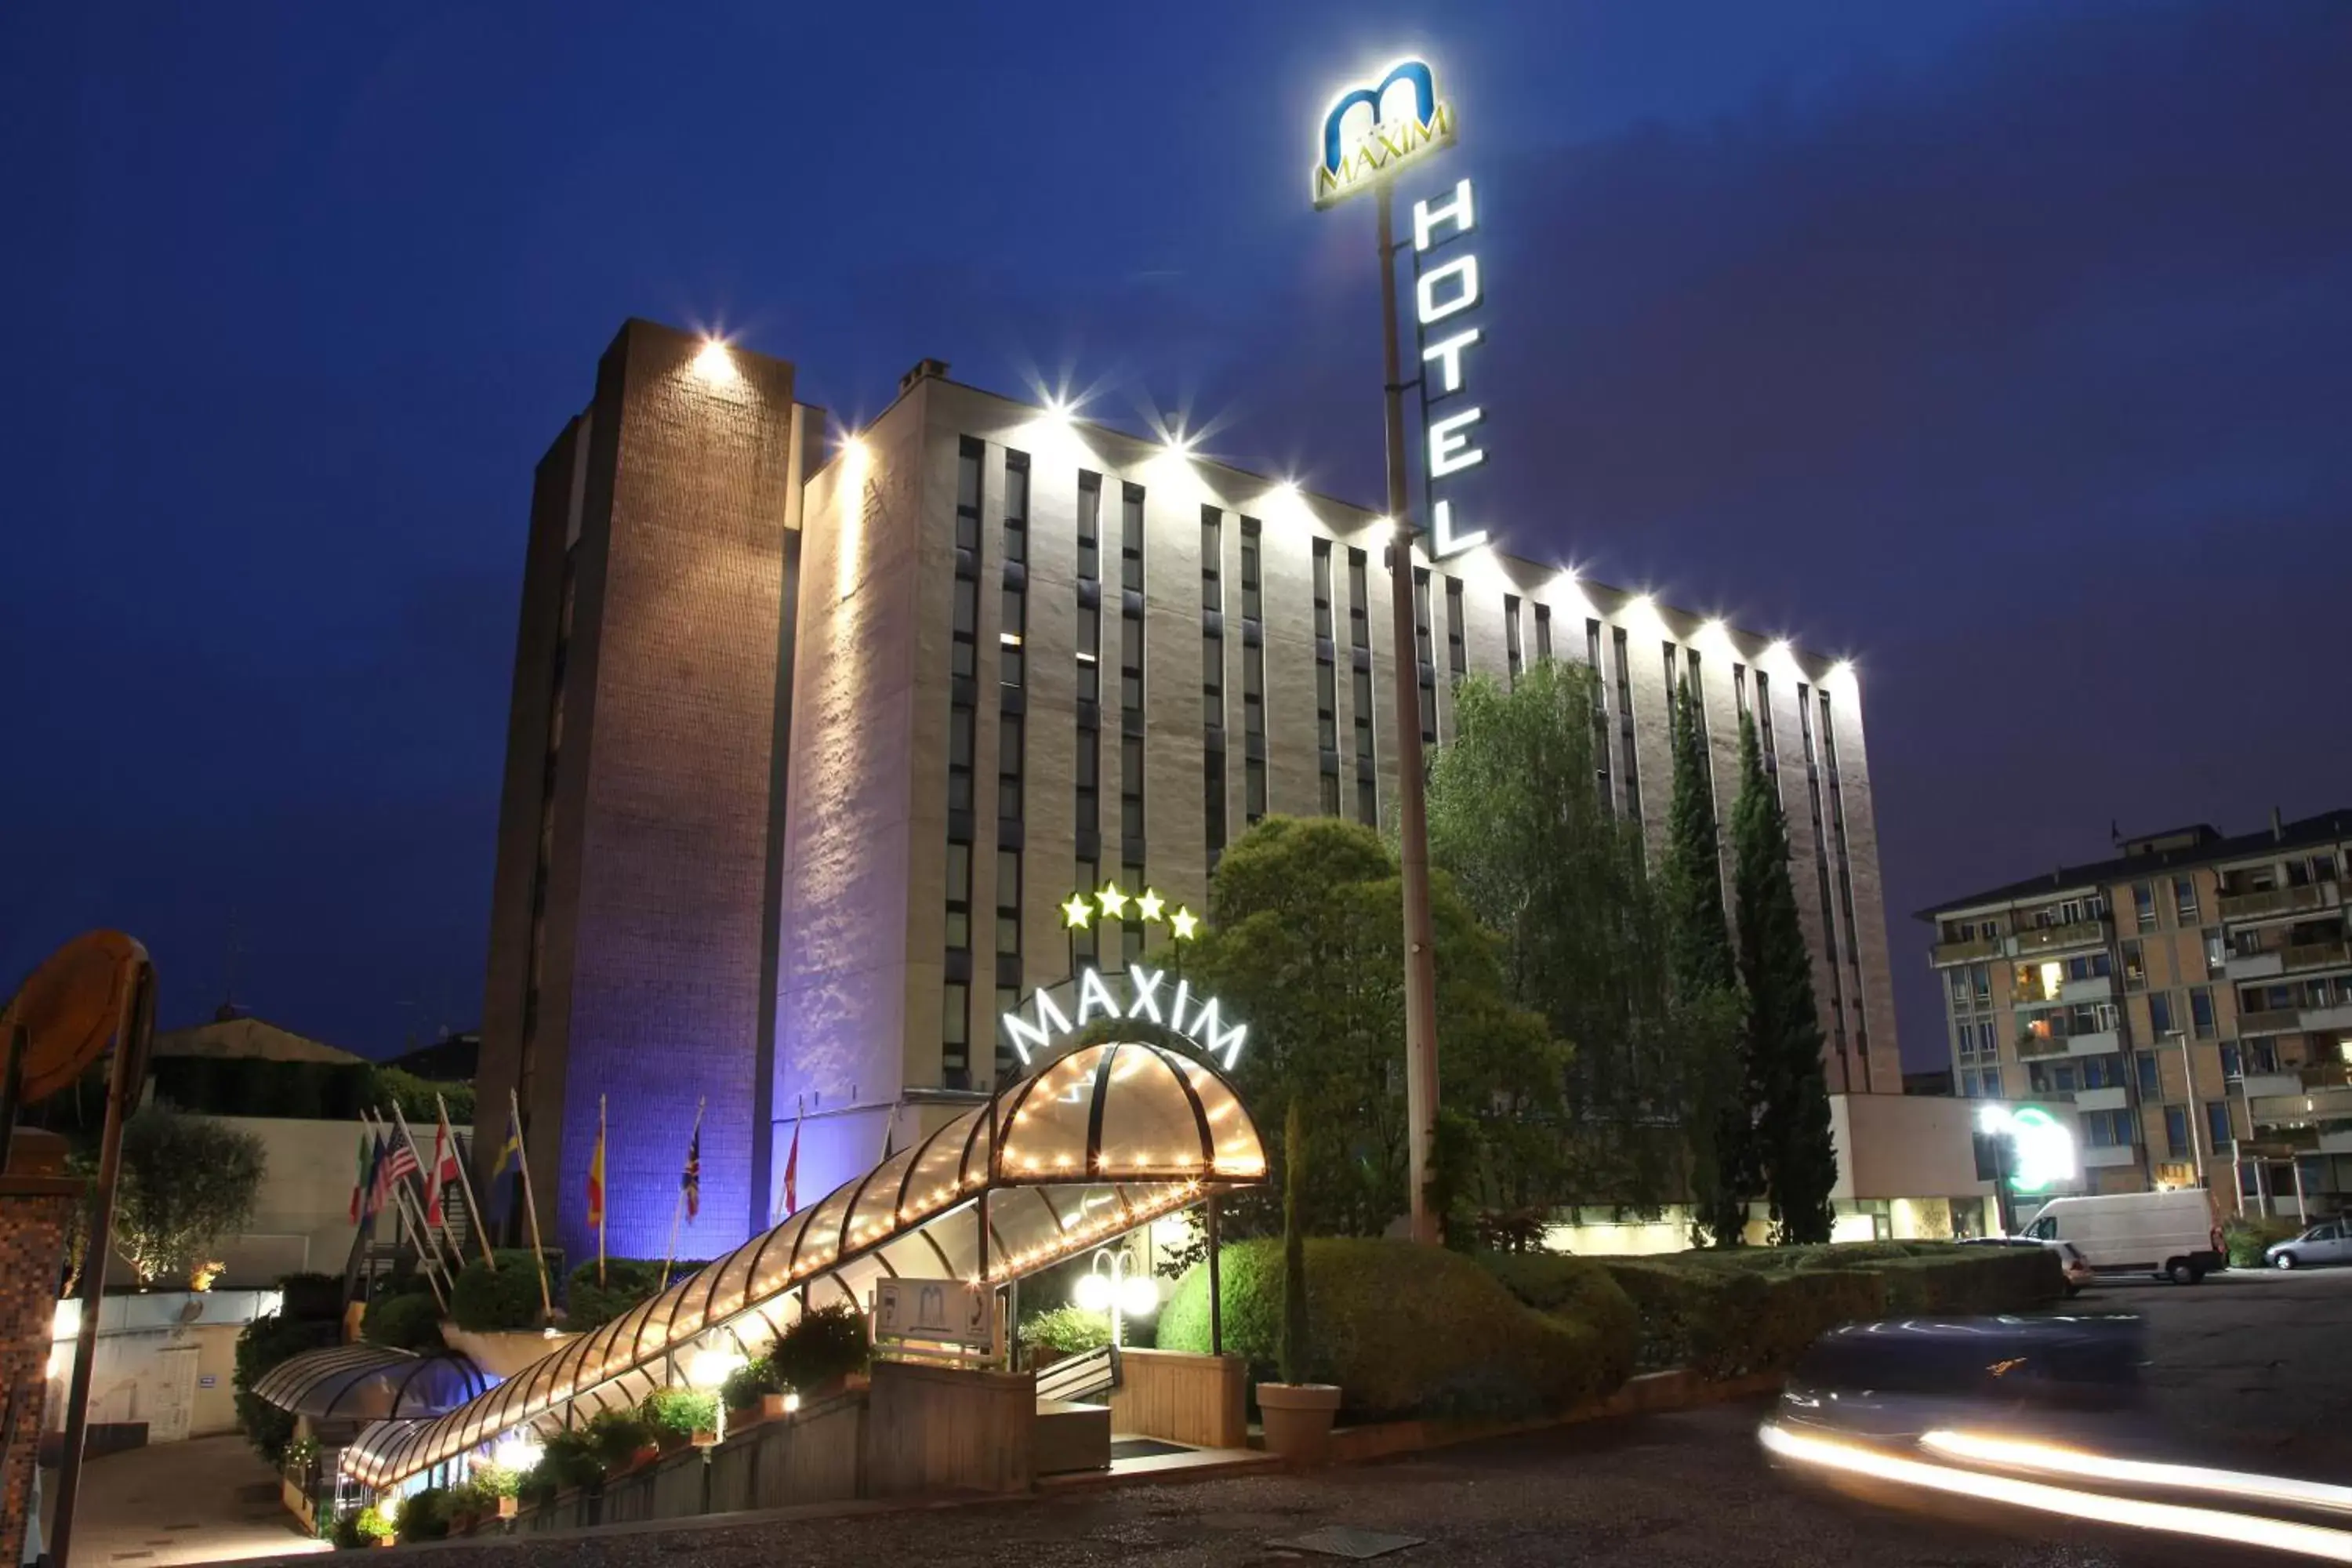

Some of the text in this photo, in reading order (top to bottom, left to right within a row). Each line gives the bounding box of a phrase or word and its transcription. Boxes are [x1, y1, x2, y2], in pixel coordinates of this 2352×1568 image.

[1319, 104, 1448, 198] MAXIM
[1414, 177, 1487, 557] HOTEL
[1002, 964, 1248, 1071] MAXIM
